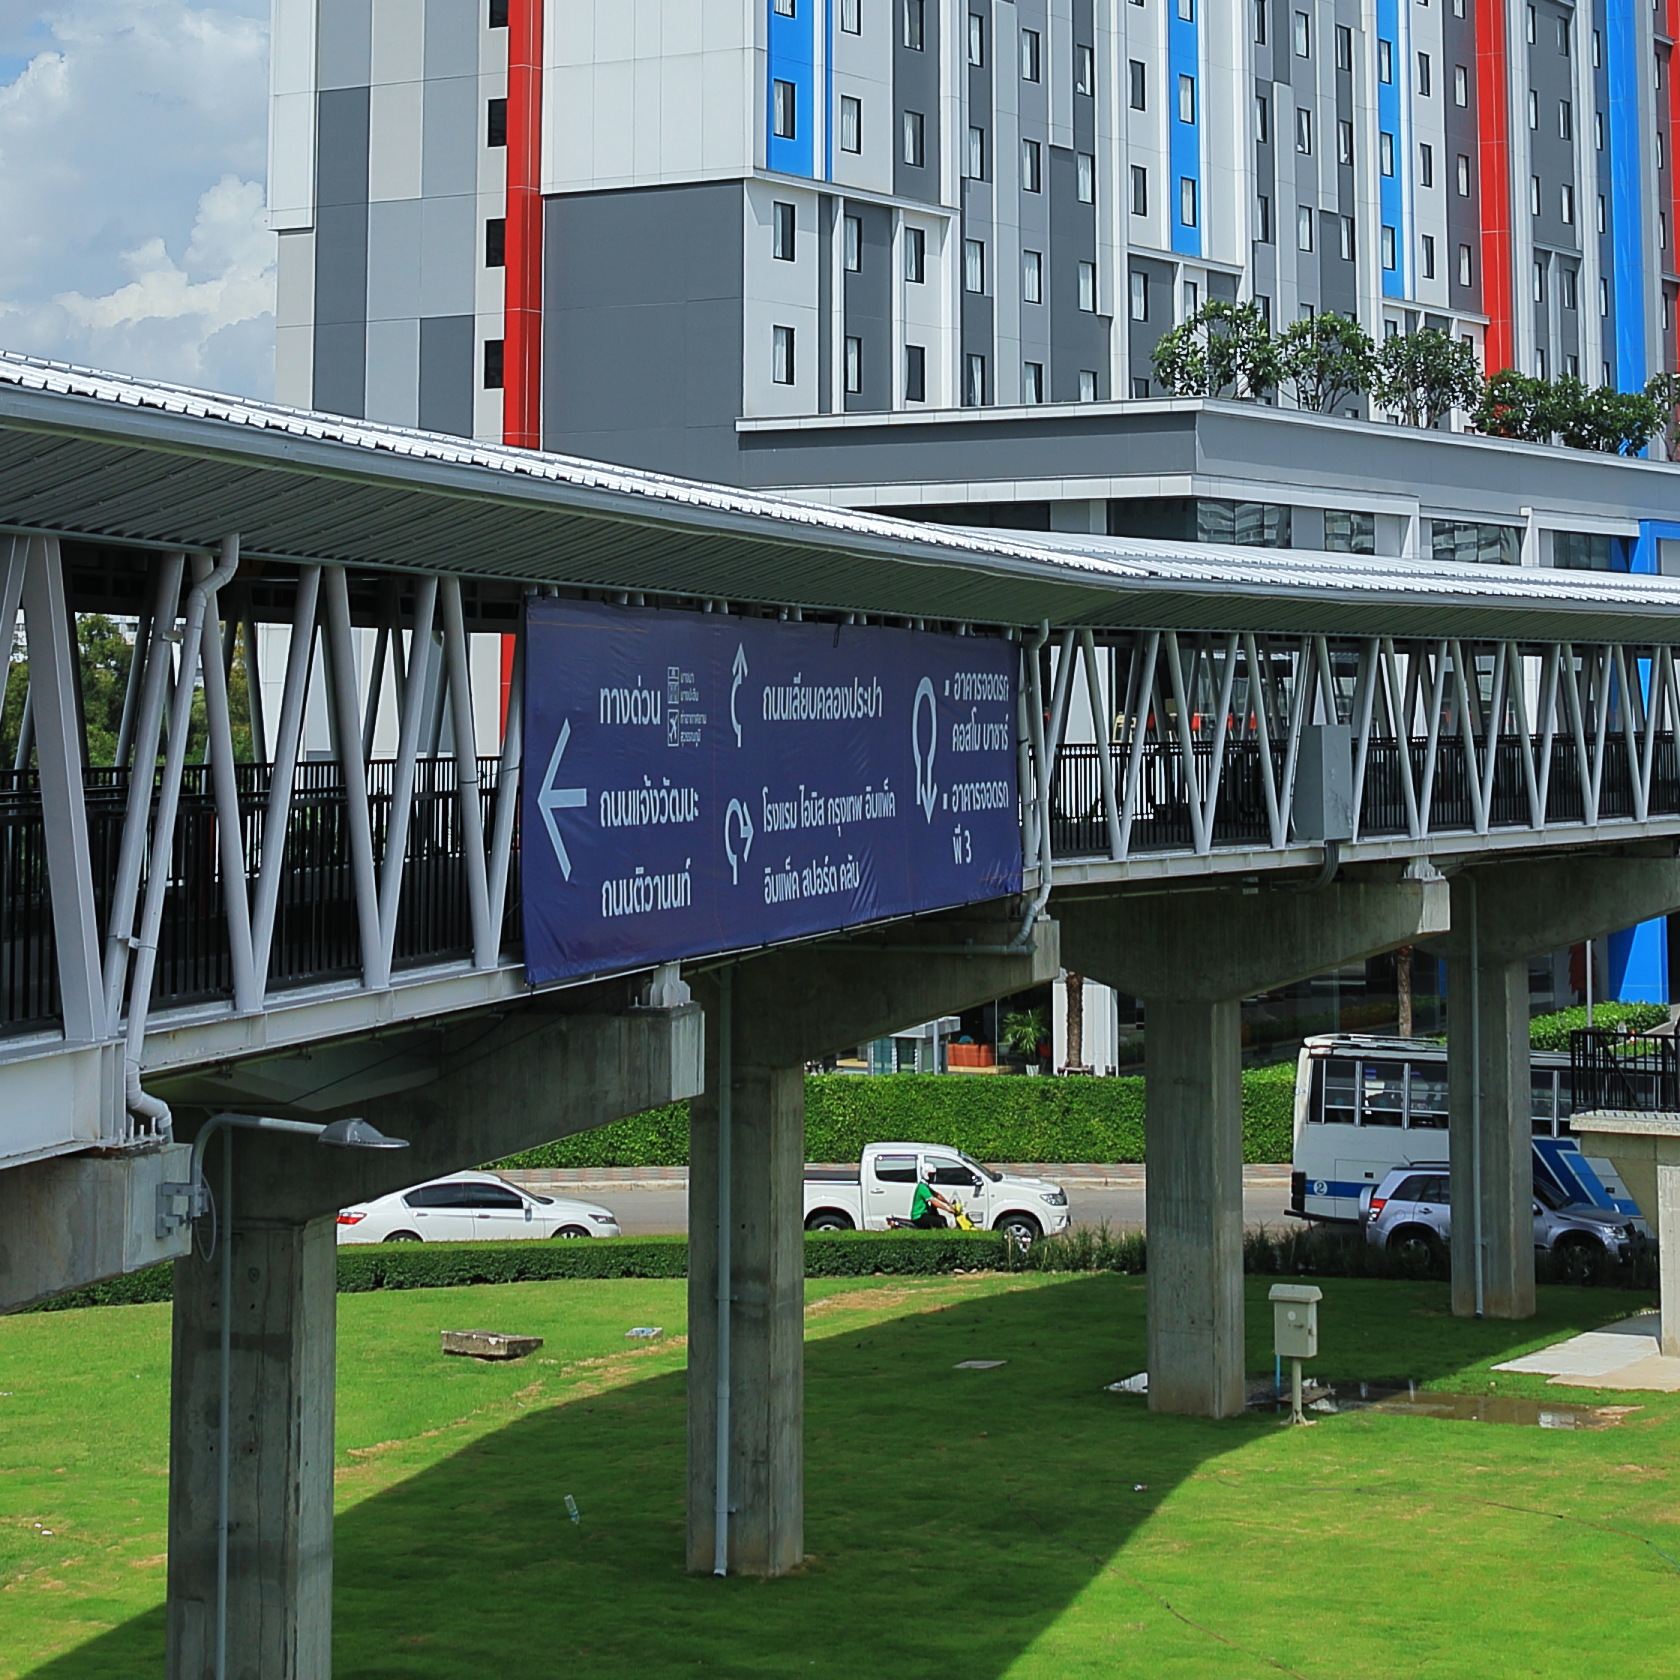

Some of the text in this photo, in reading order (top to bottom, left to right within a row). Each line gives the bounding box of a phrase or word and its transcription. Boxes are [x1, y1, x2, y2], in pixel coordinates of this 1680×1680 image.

[600, 674, 661, 725] ทางด่วน
[763, 671, 883, 721] ถนนเลียบคลองประปา
[954, 672, 1009, 702] อาคารจอดรถ
[952, 706, 981, 752] คอสโม
[600, 774, 699, 827] ถนนแจ้งวัฒนะ
[762, 777, 896, 838] โรงแรม ไอบิส กรุงเทพ อิมแพ็ค
[952, 780, 1009, 813] อาคารจอดรถ
[952, 823, 972, 865] พี 3
[602, 857, 691, 918] ถนนติวานนท์
[764, 853, 860, 904] อิมแพ็ค สปอร์ต คลับ
